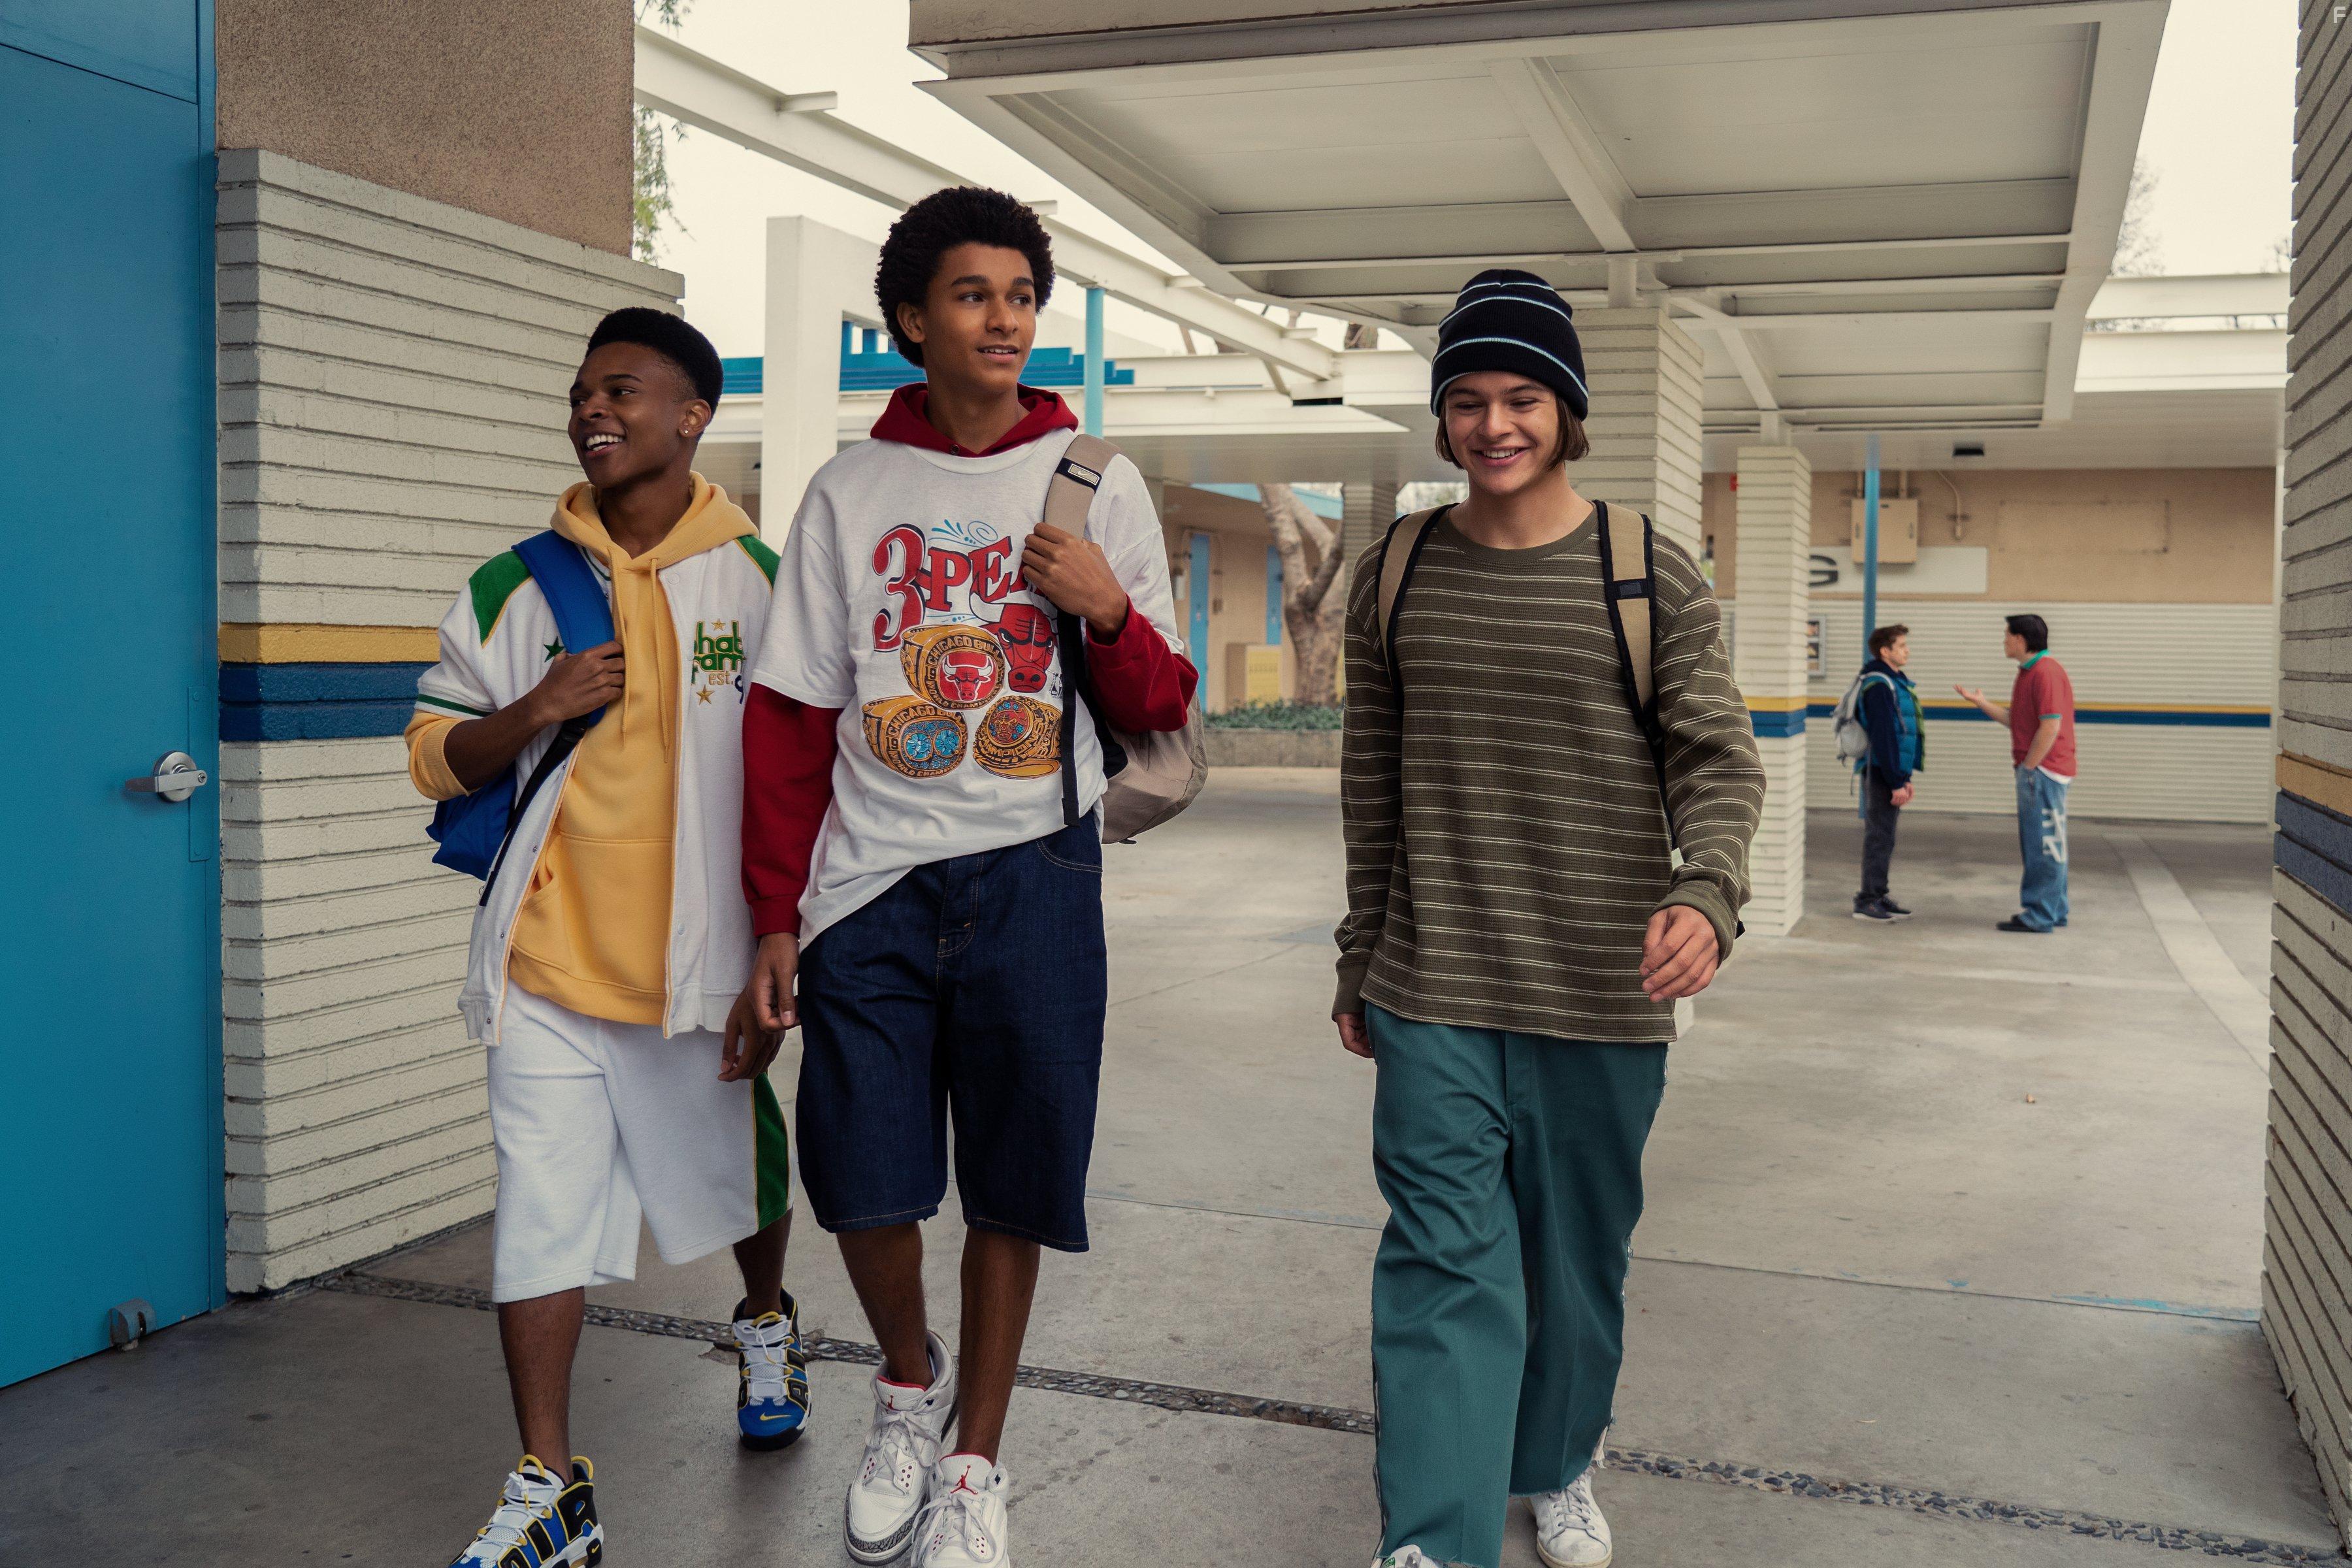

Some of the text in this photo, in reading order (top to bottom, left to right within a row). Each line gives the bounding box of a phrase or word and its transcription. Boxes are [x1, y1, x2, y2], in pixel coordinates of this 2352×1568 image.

[694, 620, 743, 655] hat
[927, 636, 972, 666] CHICAGO
[709, 670, 734, 685] est.
[926, 680, 949, 707] WORLD
[888, 705, 935, 736] CHICAGO
[888, 750, 915, 776] WORLD
